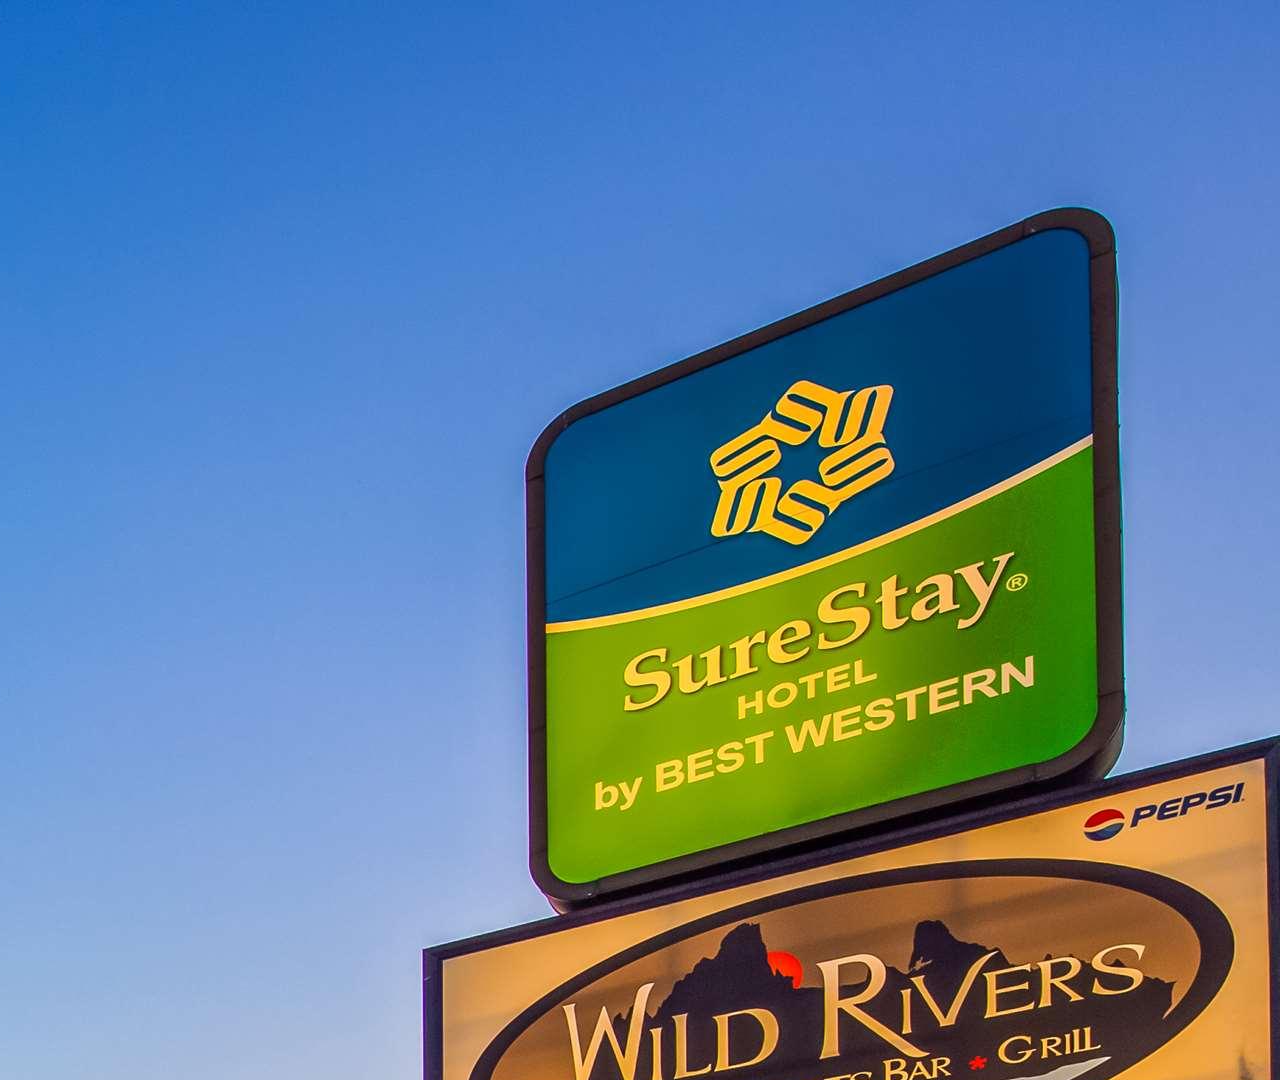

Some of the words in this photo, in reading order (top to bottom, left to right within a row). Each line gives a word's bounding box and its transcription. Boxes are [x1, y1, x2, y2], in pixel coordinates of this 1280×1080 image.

[737, 659, 878, 720] HOTEL
[594, 775, 643, 811] by
[655, 730, 774, 792] BEST
[784, 655, 1036, 754] WESTERN
[1130, 782, 1245, 828] PEPSI
[997, 1026, 1102, 1065] GRILL
